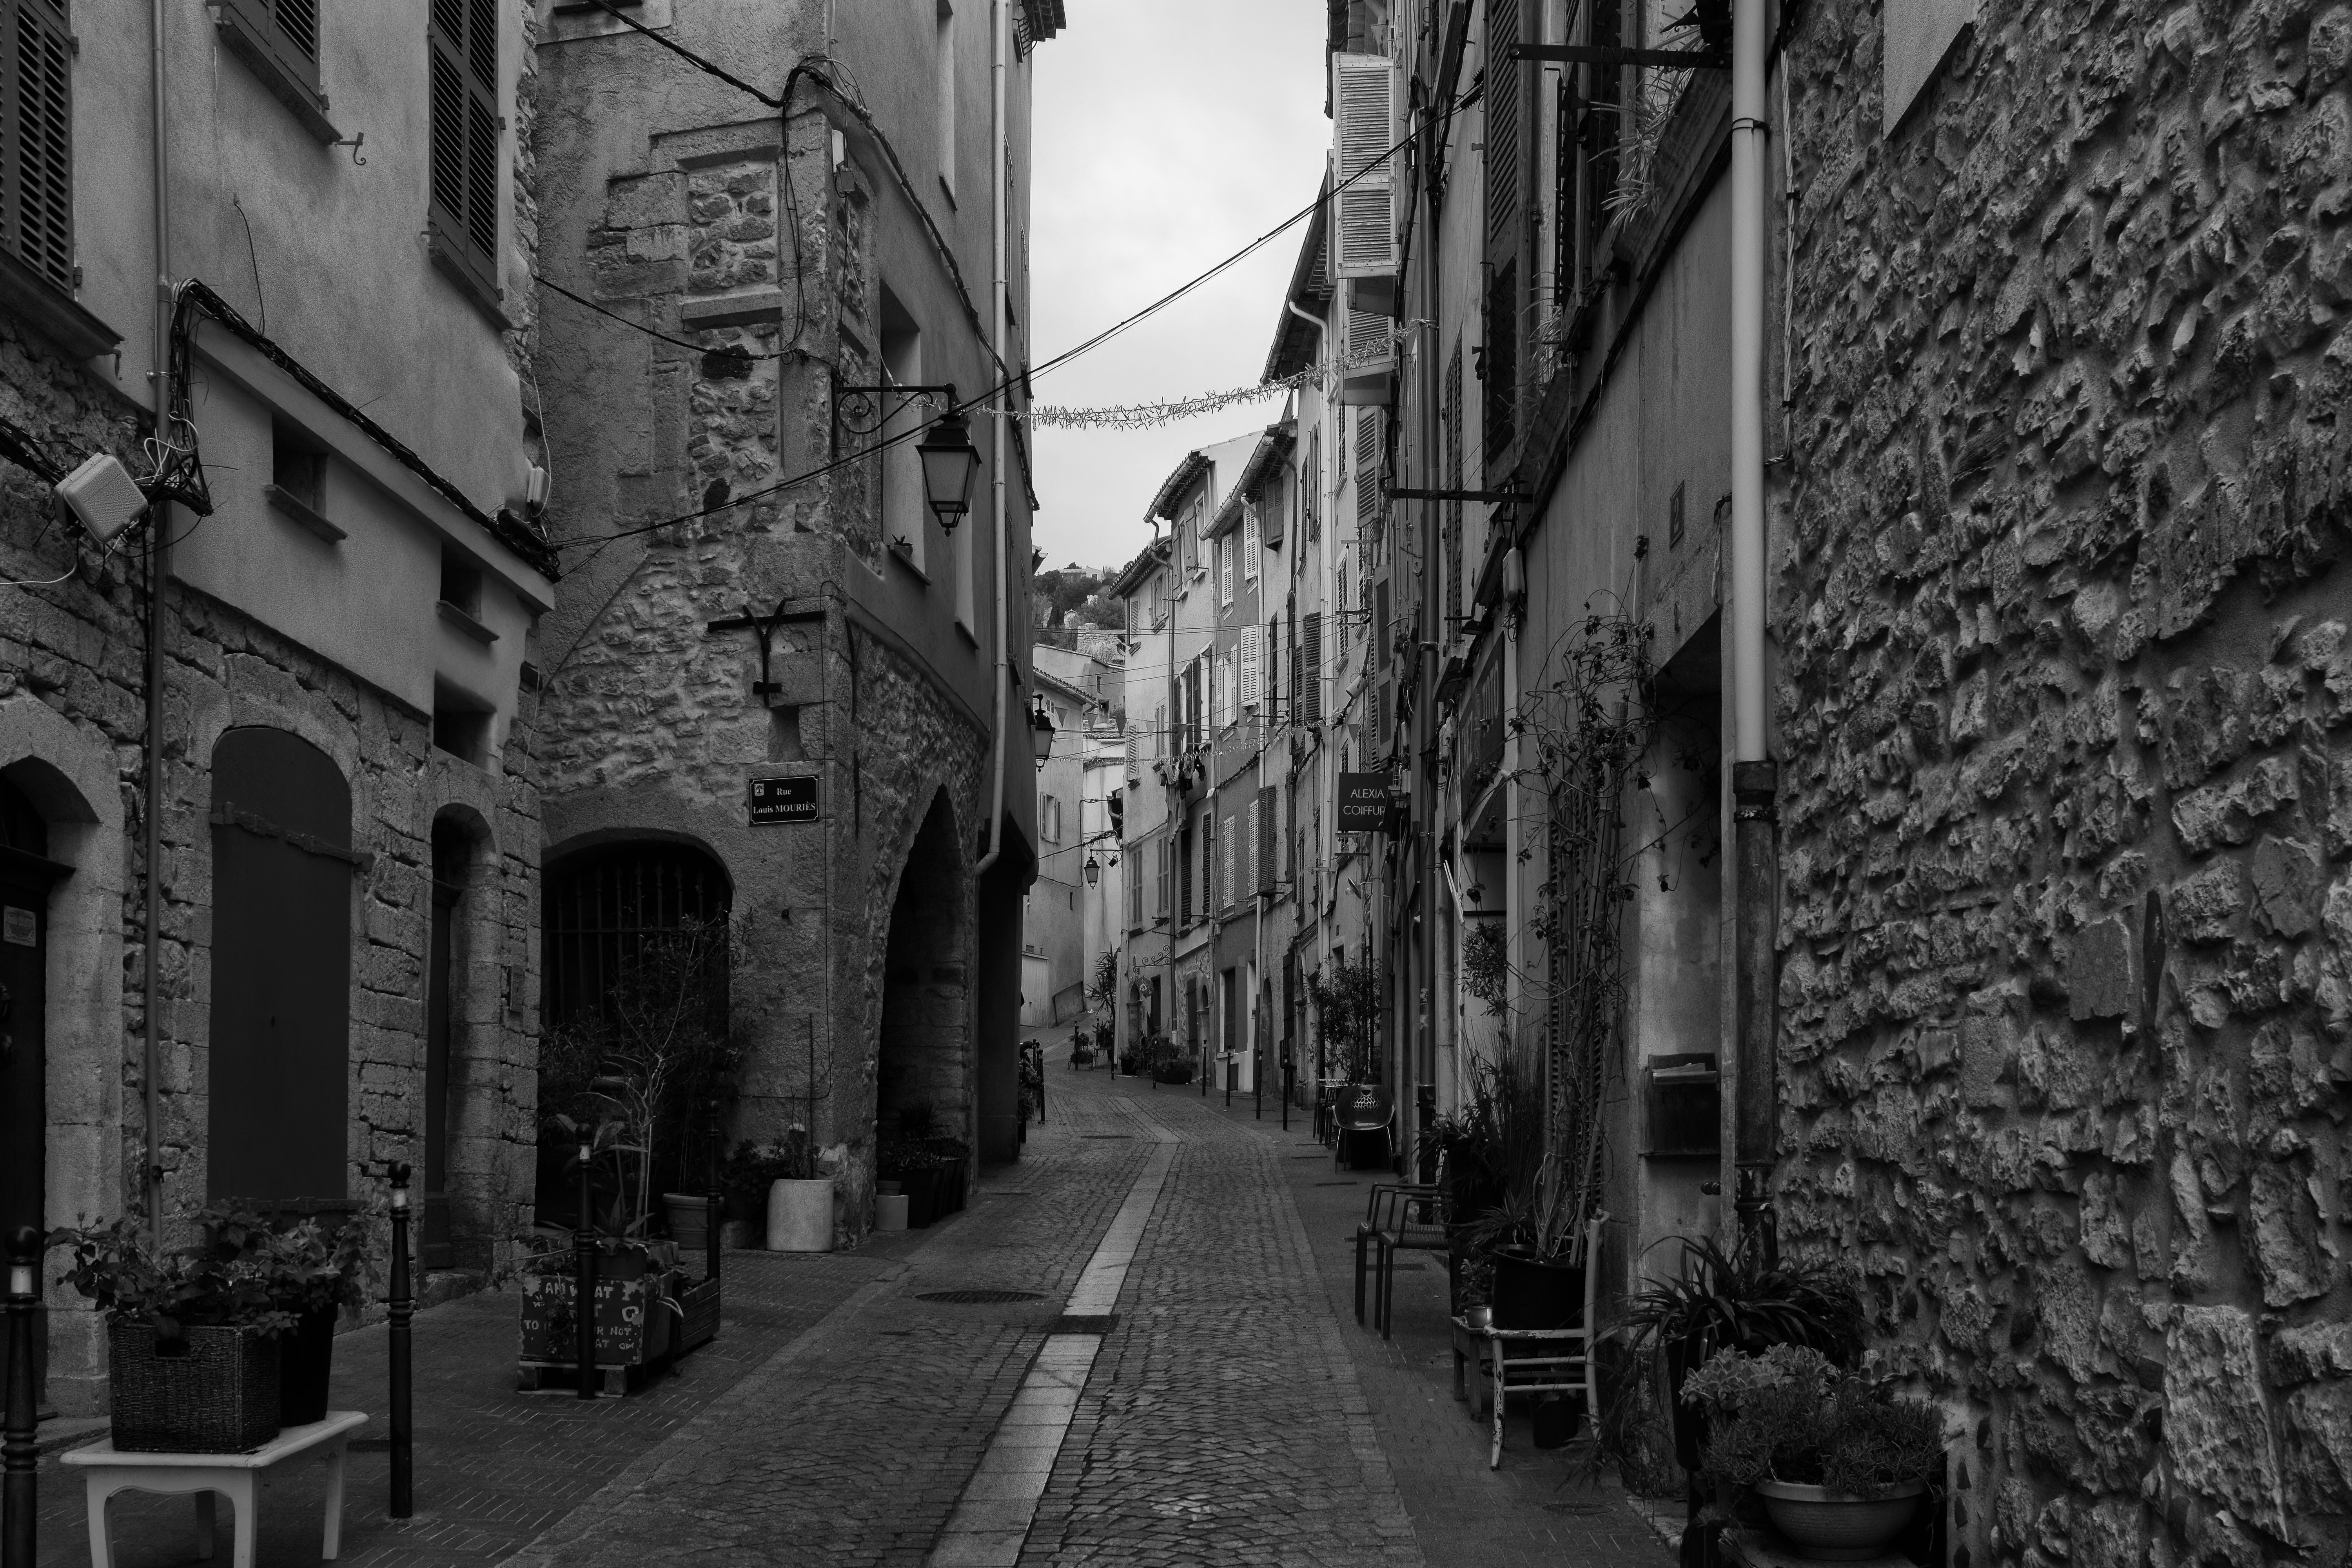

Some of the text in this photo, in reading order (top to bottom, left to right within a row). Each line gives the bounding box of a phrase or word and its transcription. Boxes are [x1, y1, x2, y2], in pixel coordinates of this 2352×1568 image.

[1351, 789, 1385, 798] ALEXIA
[753, 801, 816, 814] Louis MOURIÈS
[1343, 806, 1385, 816] COIFFUR
[524, 1320, 539, 1330] TO
